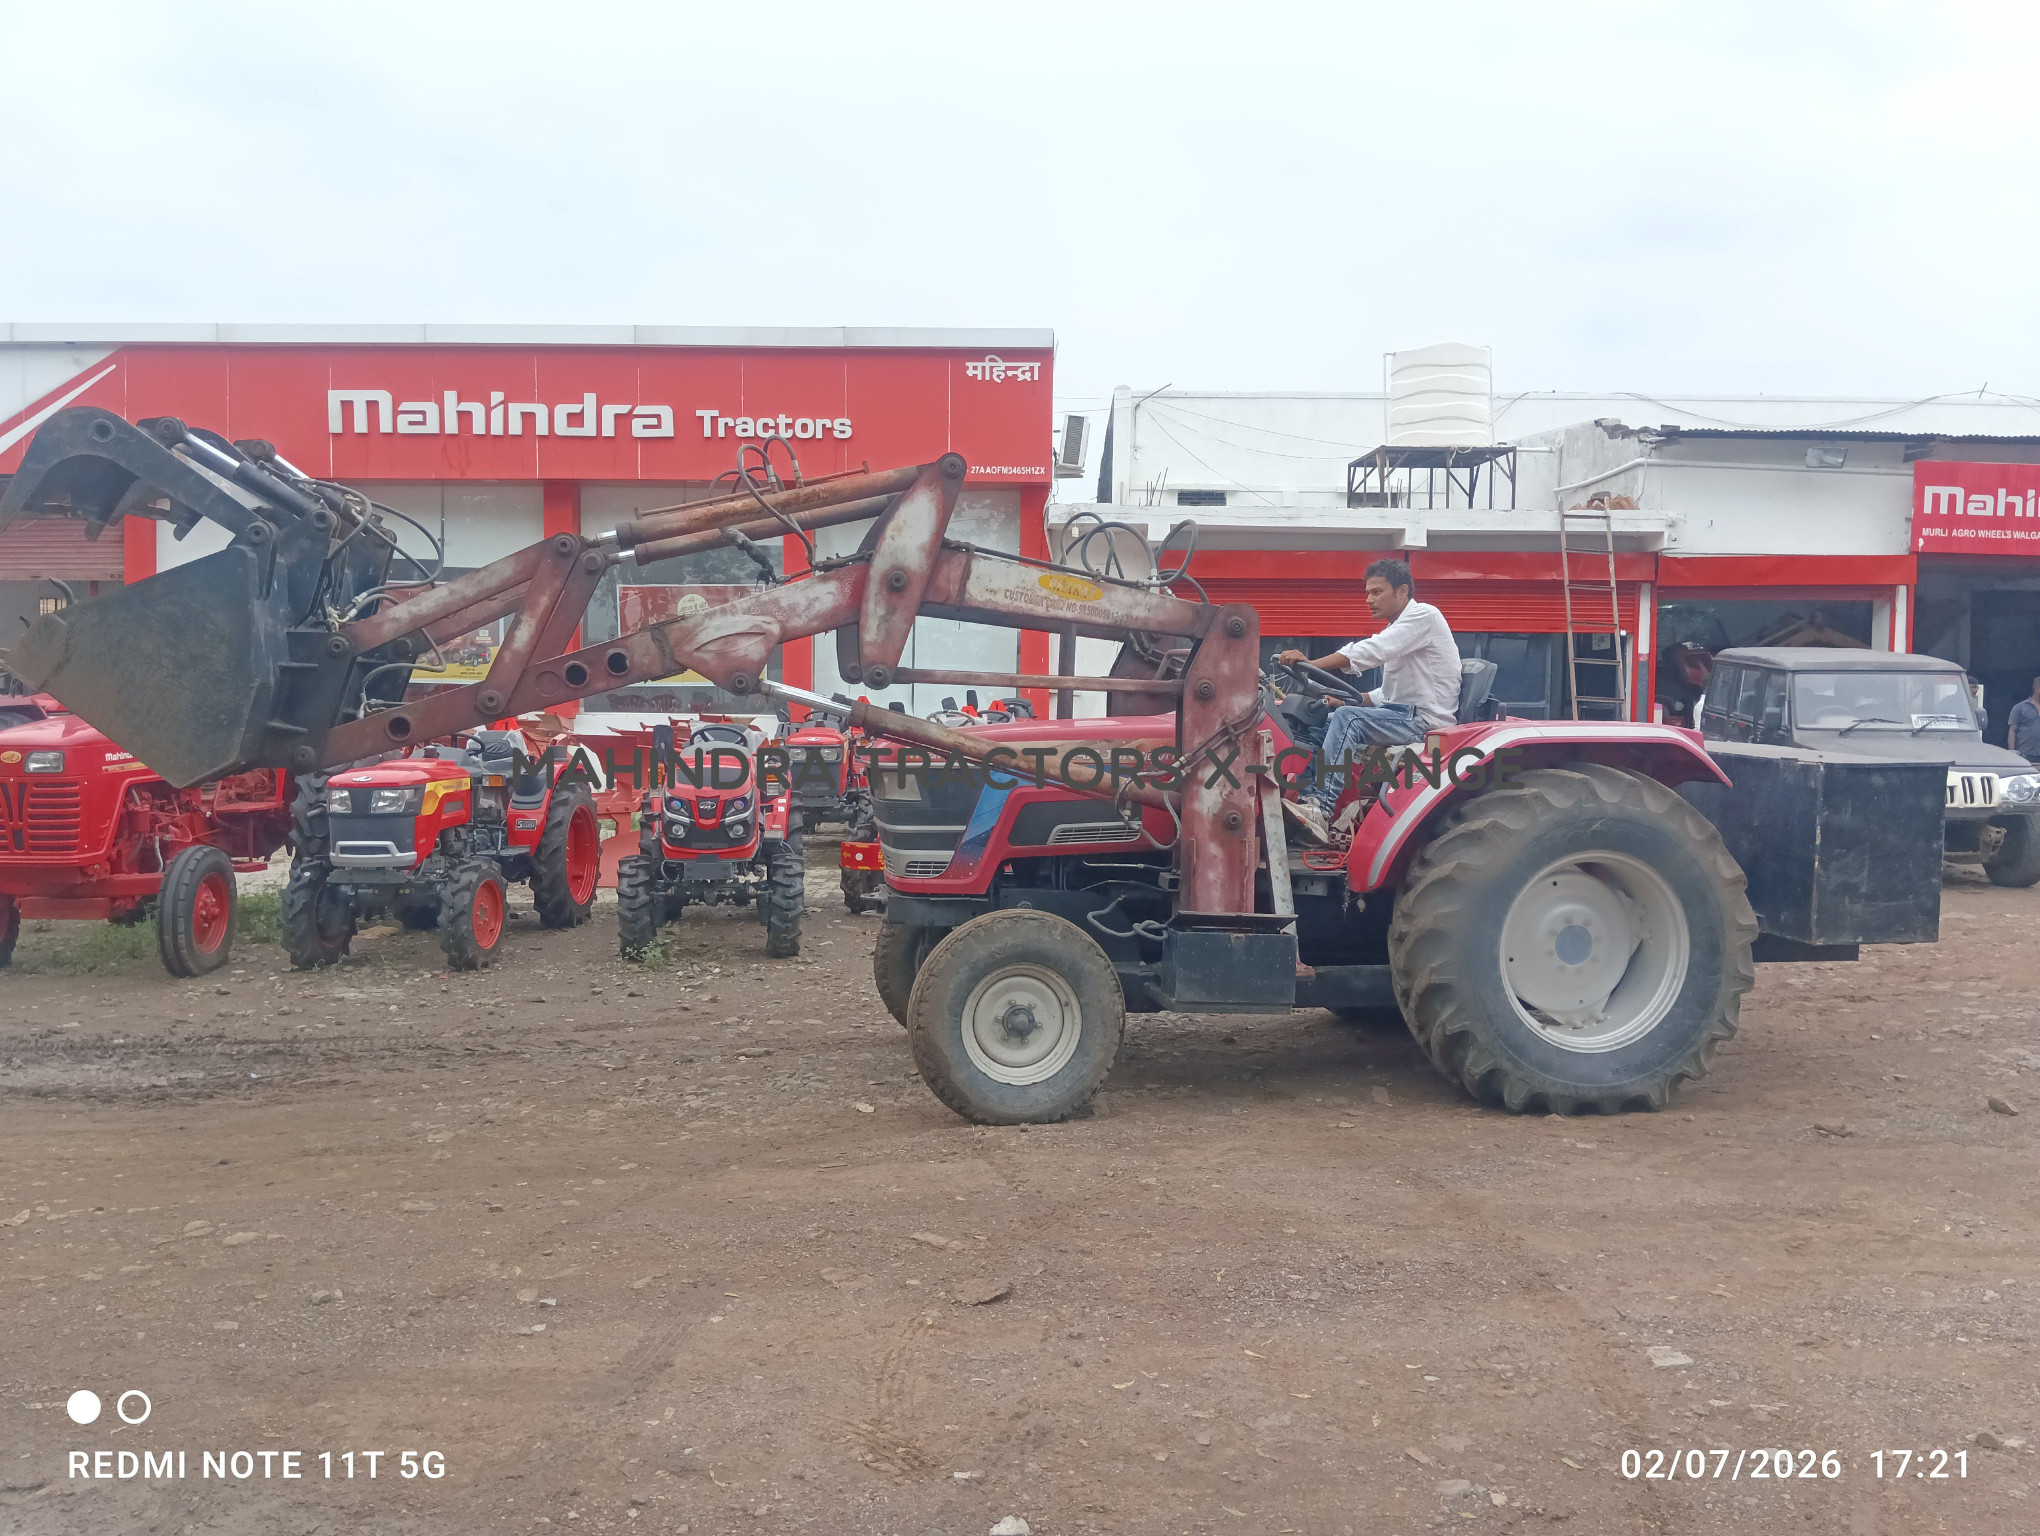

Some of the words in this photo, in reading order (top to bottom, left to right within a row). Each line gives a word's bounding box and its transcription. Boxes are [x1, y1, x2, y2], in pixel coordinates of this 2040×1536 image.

[965, 354, 1041, 383] महिन्द्रा
[328, 389, 674, 438] Mahindra
[696, 409, 853, 439] Tractors
[1923, 486, 2040, 518] Mahi
[1922, 528, 1948, 537] MURLI
[1952, 528, 1976, 538] AGRO
